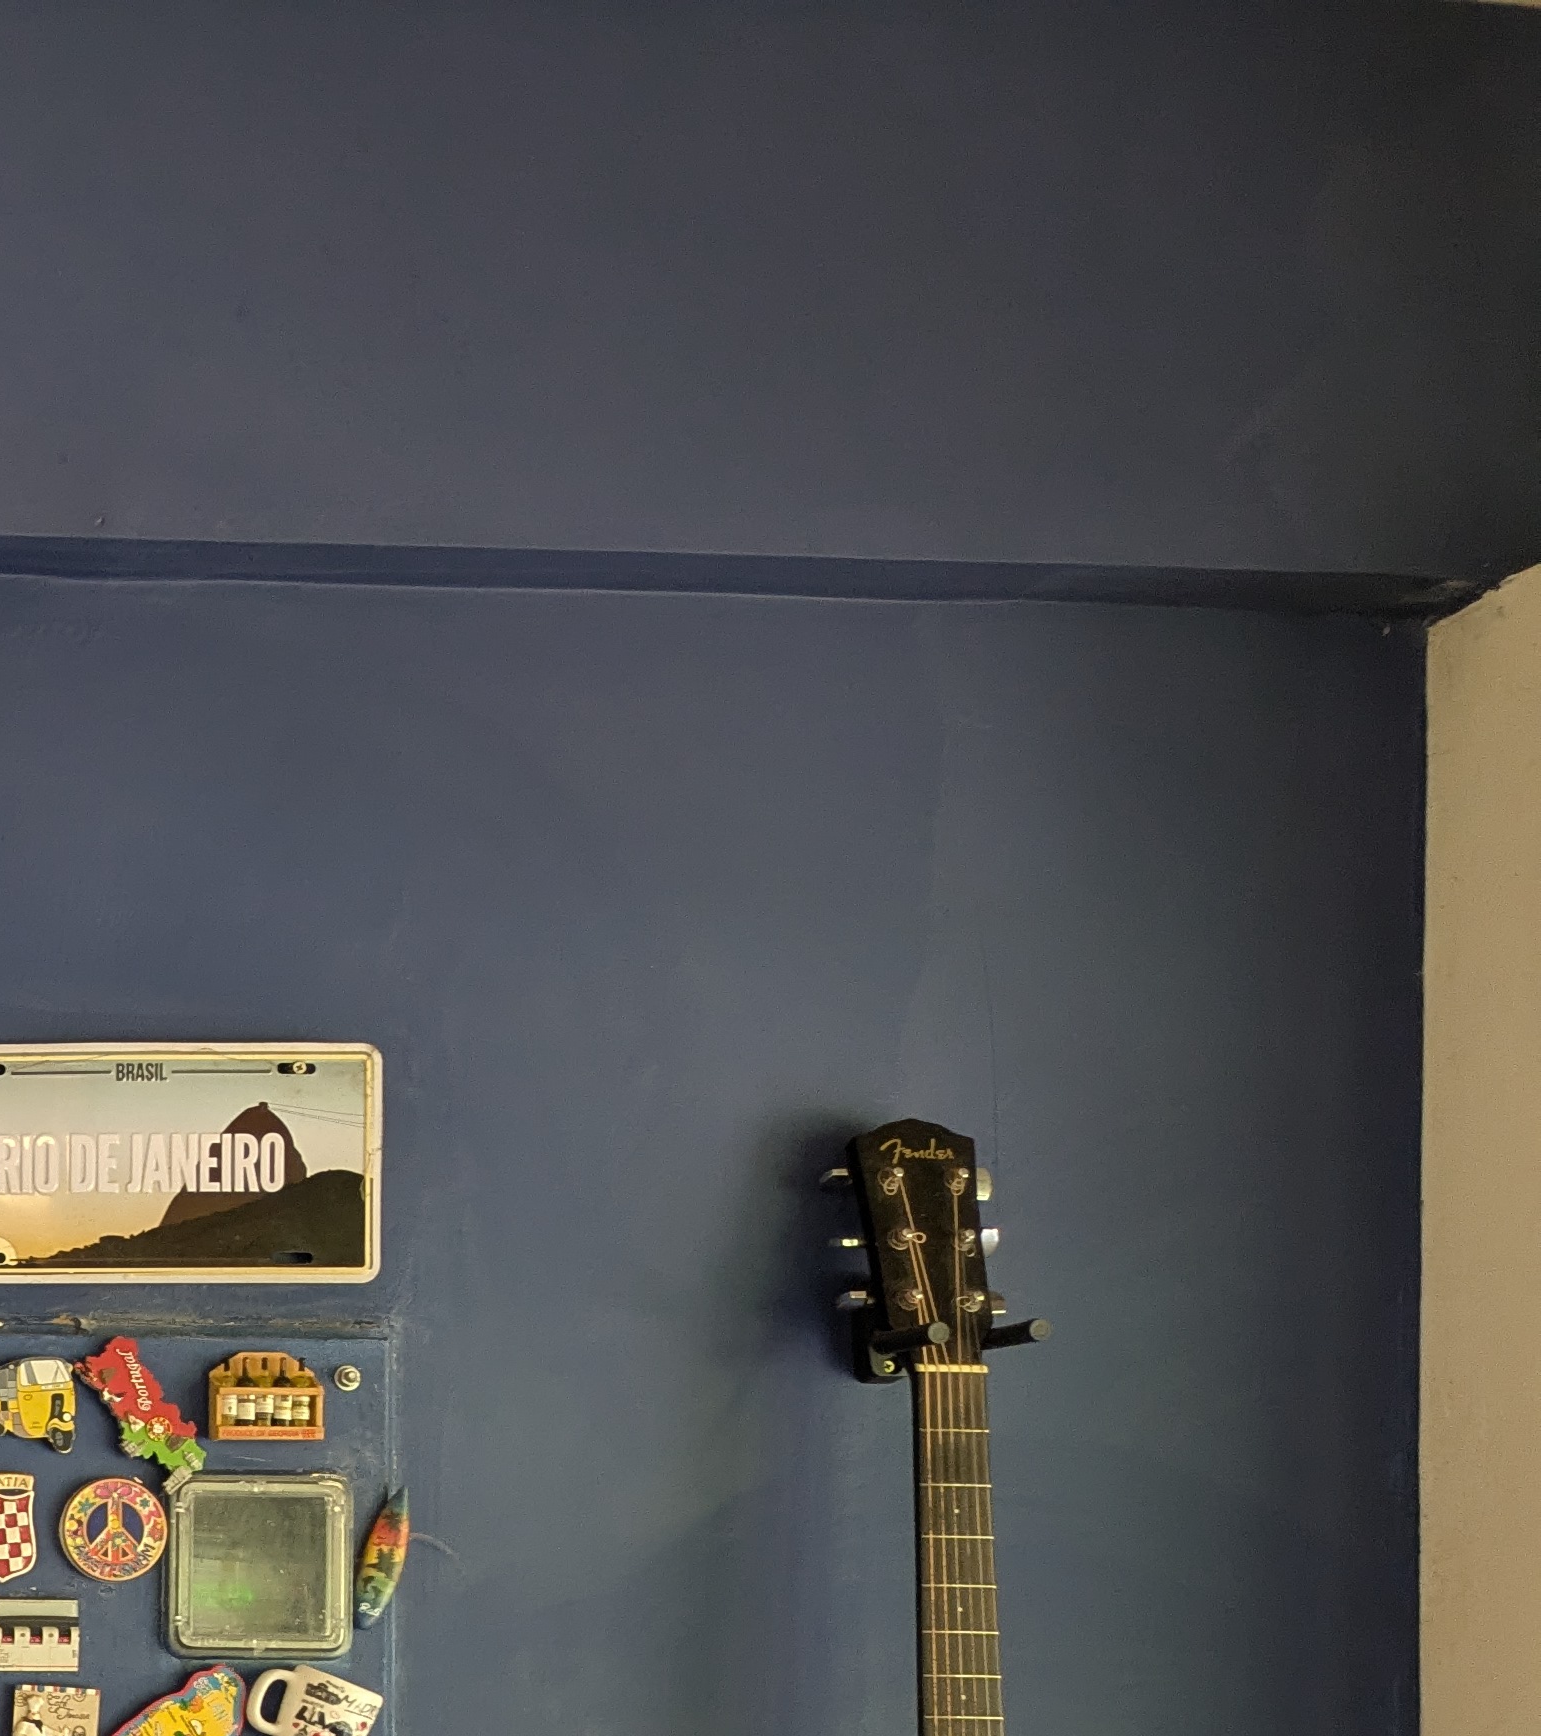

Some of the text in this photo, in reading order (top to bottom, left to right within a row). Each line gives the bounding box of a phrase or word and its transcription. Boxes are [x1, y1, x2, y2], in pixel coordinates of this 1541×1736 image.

[115, 1063, 168, 1083] BRASIL
[68, 1133, 120, 1195] DE
[126, 1132, 286, 1194] JANEIRO
[879, 1138, 955, 1165] Fender
[116, 1347, 153, 1413] Portugal
